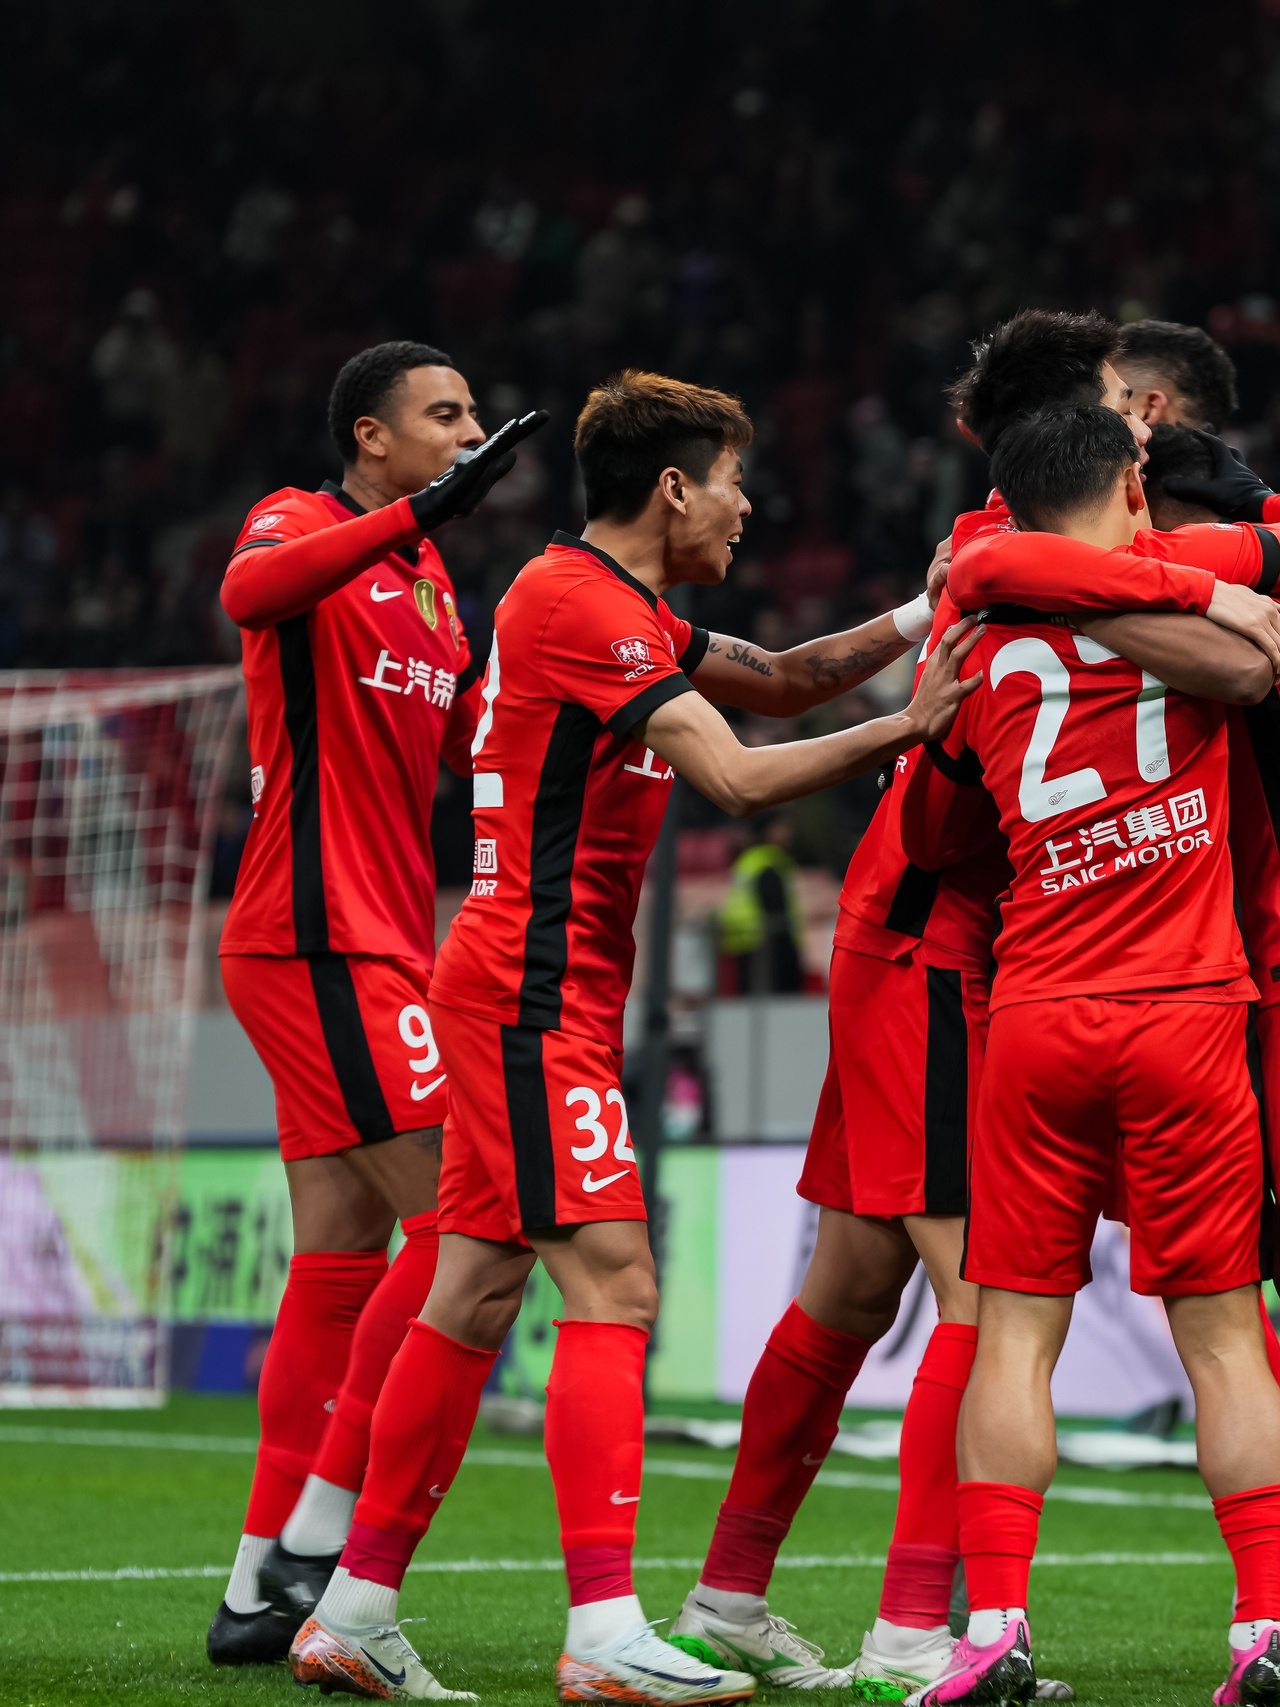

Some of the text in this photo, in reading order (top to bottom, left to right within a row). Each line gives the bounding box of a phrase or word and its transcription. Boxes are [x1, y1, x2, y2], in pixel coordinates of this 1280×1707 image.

[358, 649, 457, 711] 上汽荣
[725, 643, 773, 677] Shuai
[989, 634, 1171, 823] 27
[623, 747, 675, 780] 上
[473, 838, 498, 874] 团
[1040, 787, 1208, 876] 上汽集团
[1040, 829, 1214, 896] SAIC MOTOR
[398, 1004, 440, 1073] 9
[565, 1086, 637, 1164] 32
